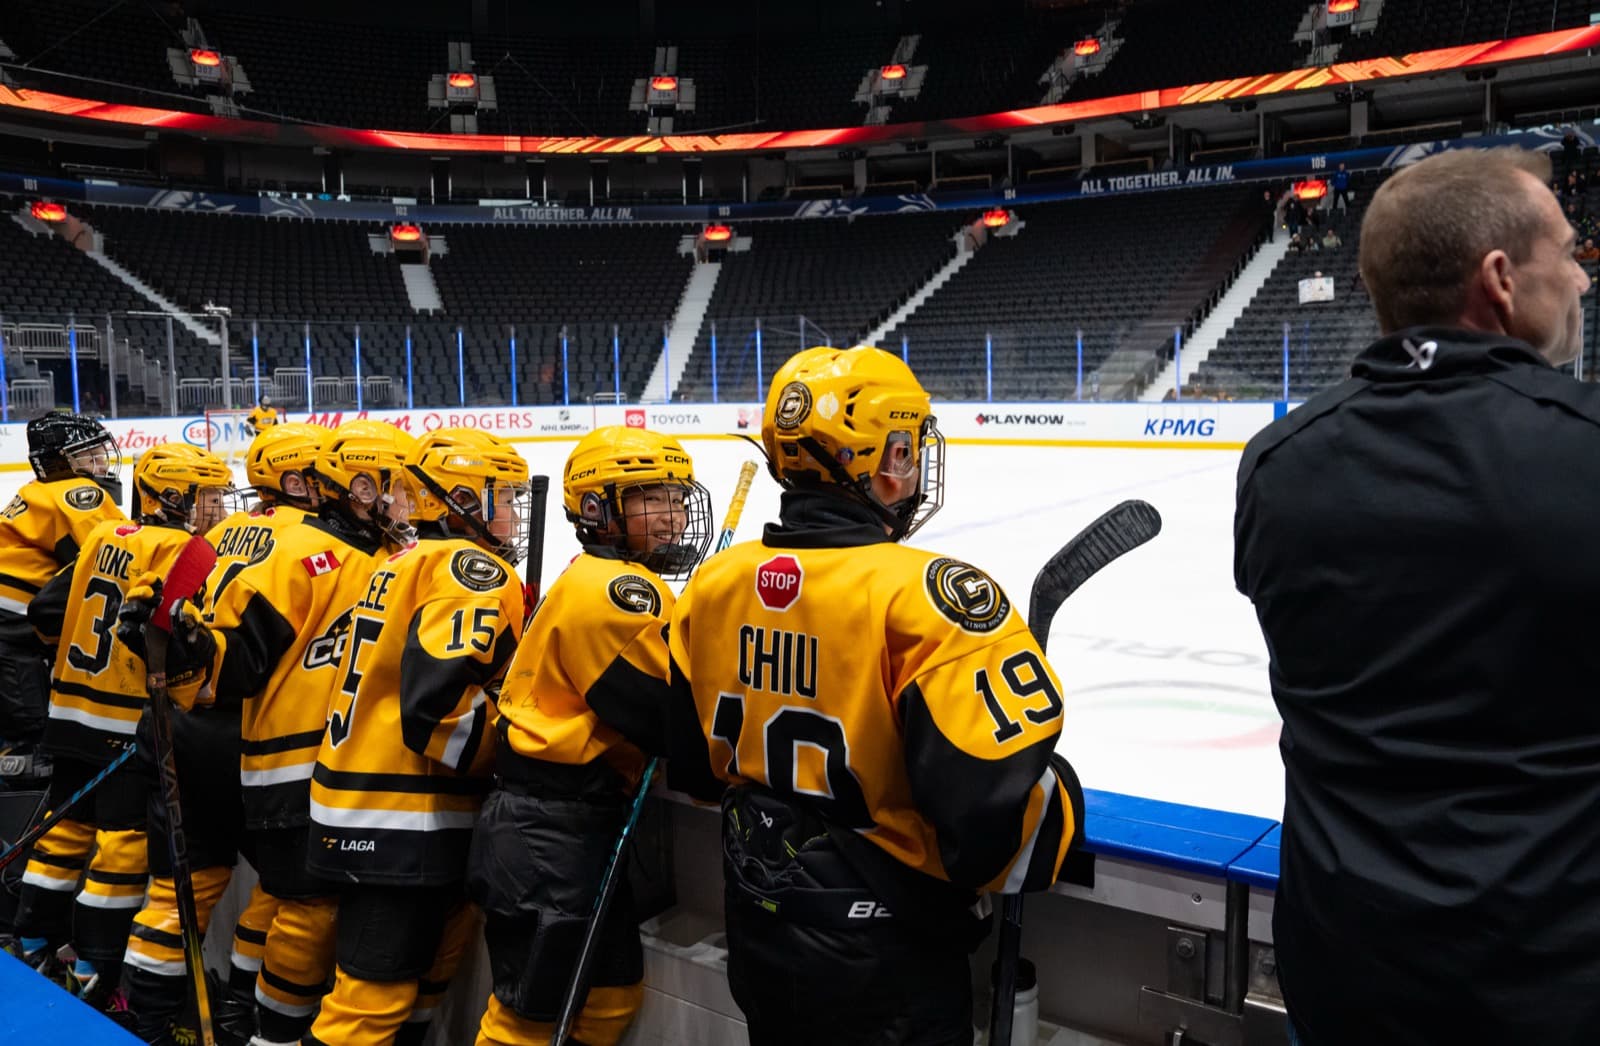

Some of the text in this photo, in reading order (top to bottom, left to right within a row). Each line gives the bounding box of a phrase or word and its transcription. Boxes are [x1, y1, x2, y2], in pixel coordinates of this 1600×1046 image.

[1312, 156, 1326, 170] 105
[1080, 166, 1235, 195] ALL TOGETHER. ALL IN.
[493, 207, 633, 220] ALL TOGETHER. ALL IN.
[449, 412, 533, 430] ROGERS
[652, 414, 701, 425] TOYOTA
[889, 410, 919, 420] CCM
[984, 414, 1064, 425] PLAYNOW
[1144, 418, 1215, 437] KPMG
[272, 453, 299, 463] CCM
[345, 454, 376, 462] CCM
[665, 455, 689, 465] CCM
[571, 467, 597, 481] CCM
[760, 571, 797, 591] STOP
[445, 607, 499, 653] 15
[738, 623, 819, 699] CHIU
[975, 649, 1063, 744] 19
[341, 839, 375, 852] LAGA
